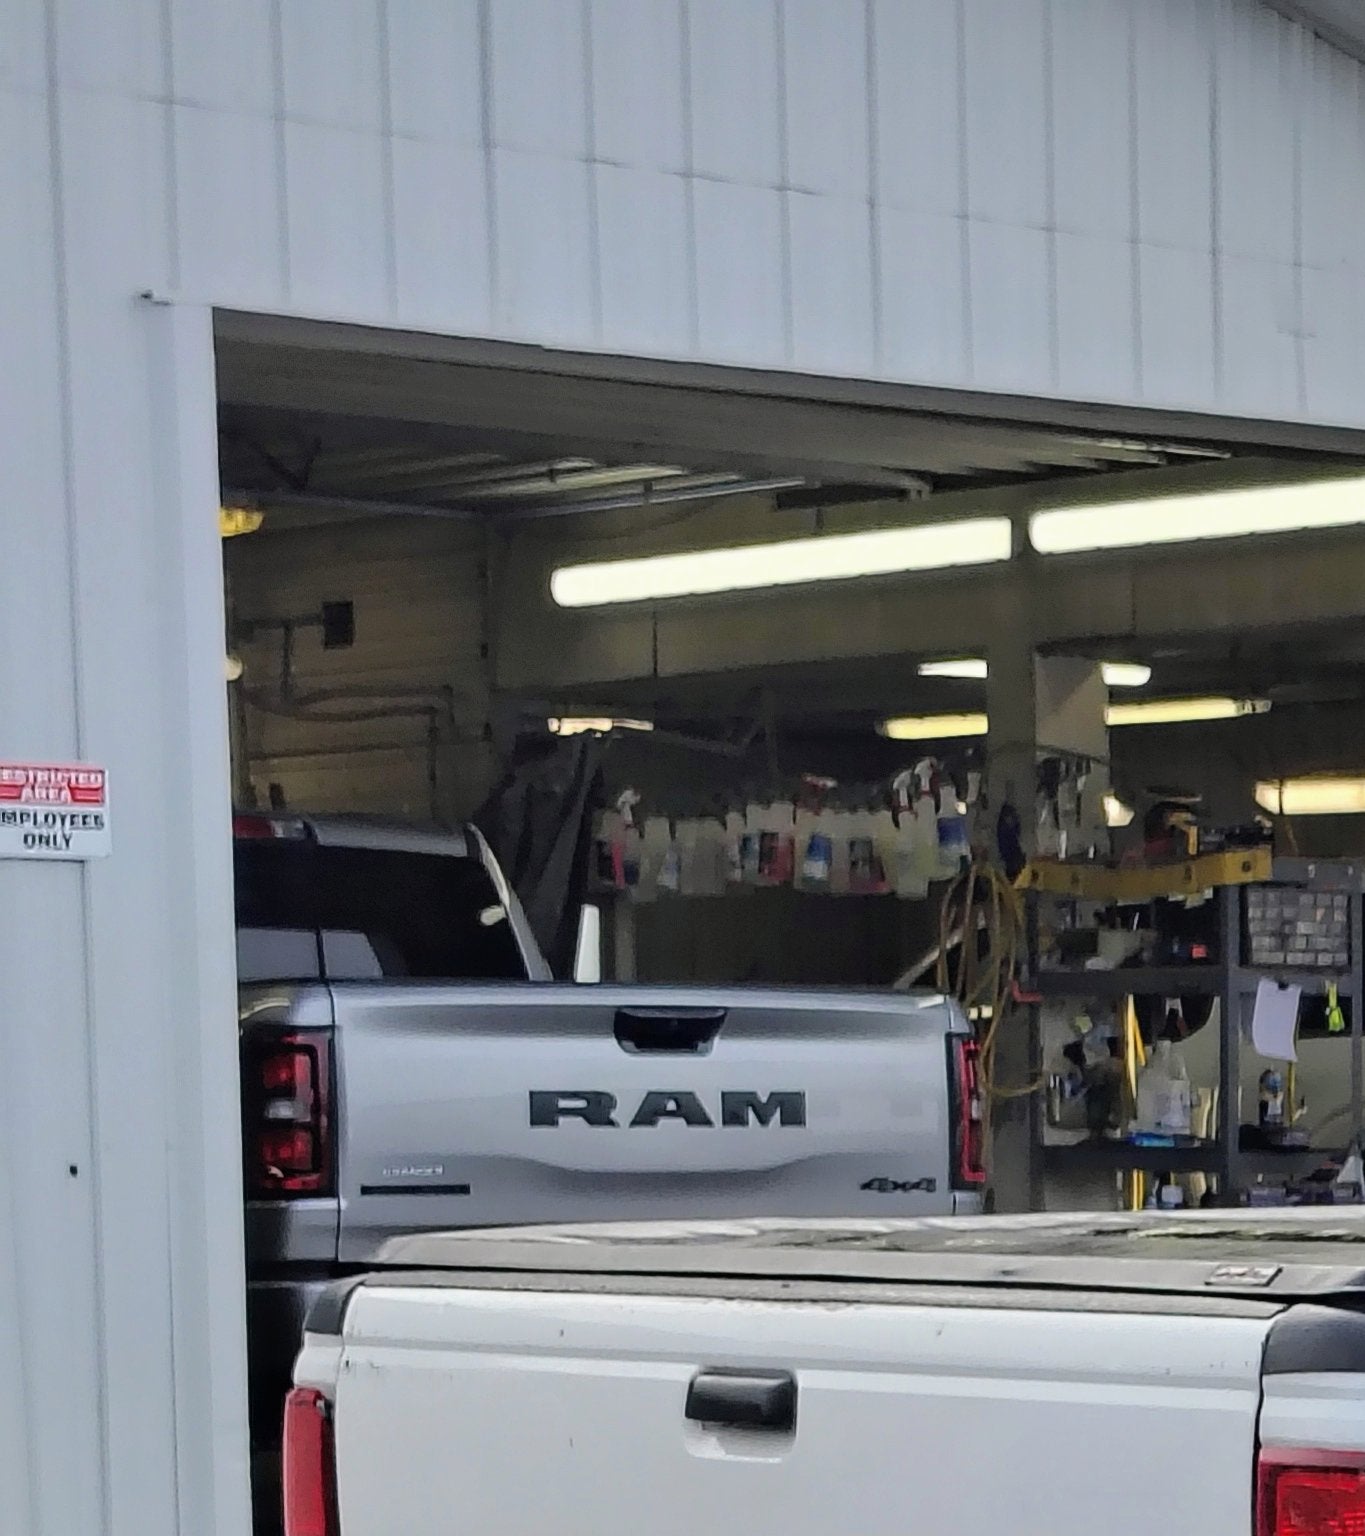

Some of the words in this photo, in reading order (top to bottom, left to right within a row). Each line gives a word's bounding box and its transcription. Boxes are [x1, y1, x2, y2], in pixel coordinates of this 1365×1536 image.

[0, 768, 103, 785] ESTRICTED
[21, 786, 72, 803] AREA
[0, 811, 104, 828] MPLOYEES
[23, 832, 73, 850] ONLY
[529, 1090, 807, 1128] RAM
